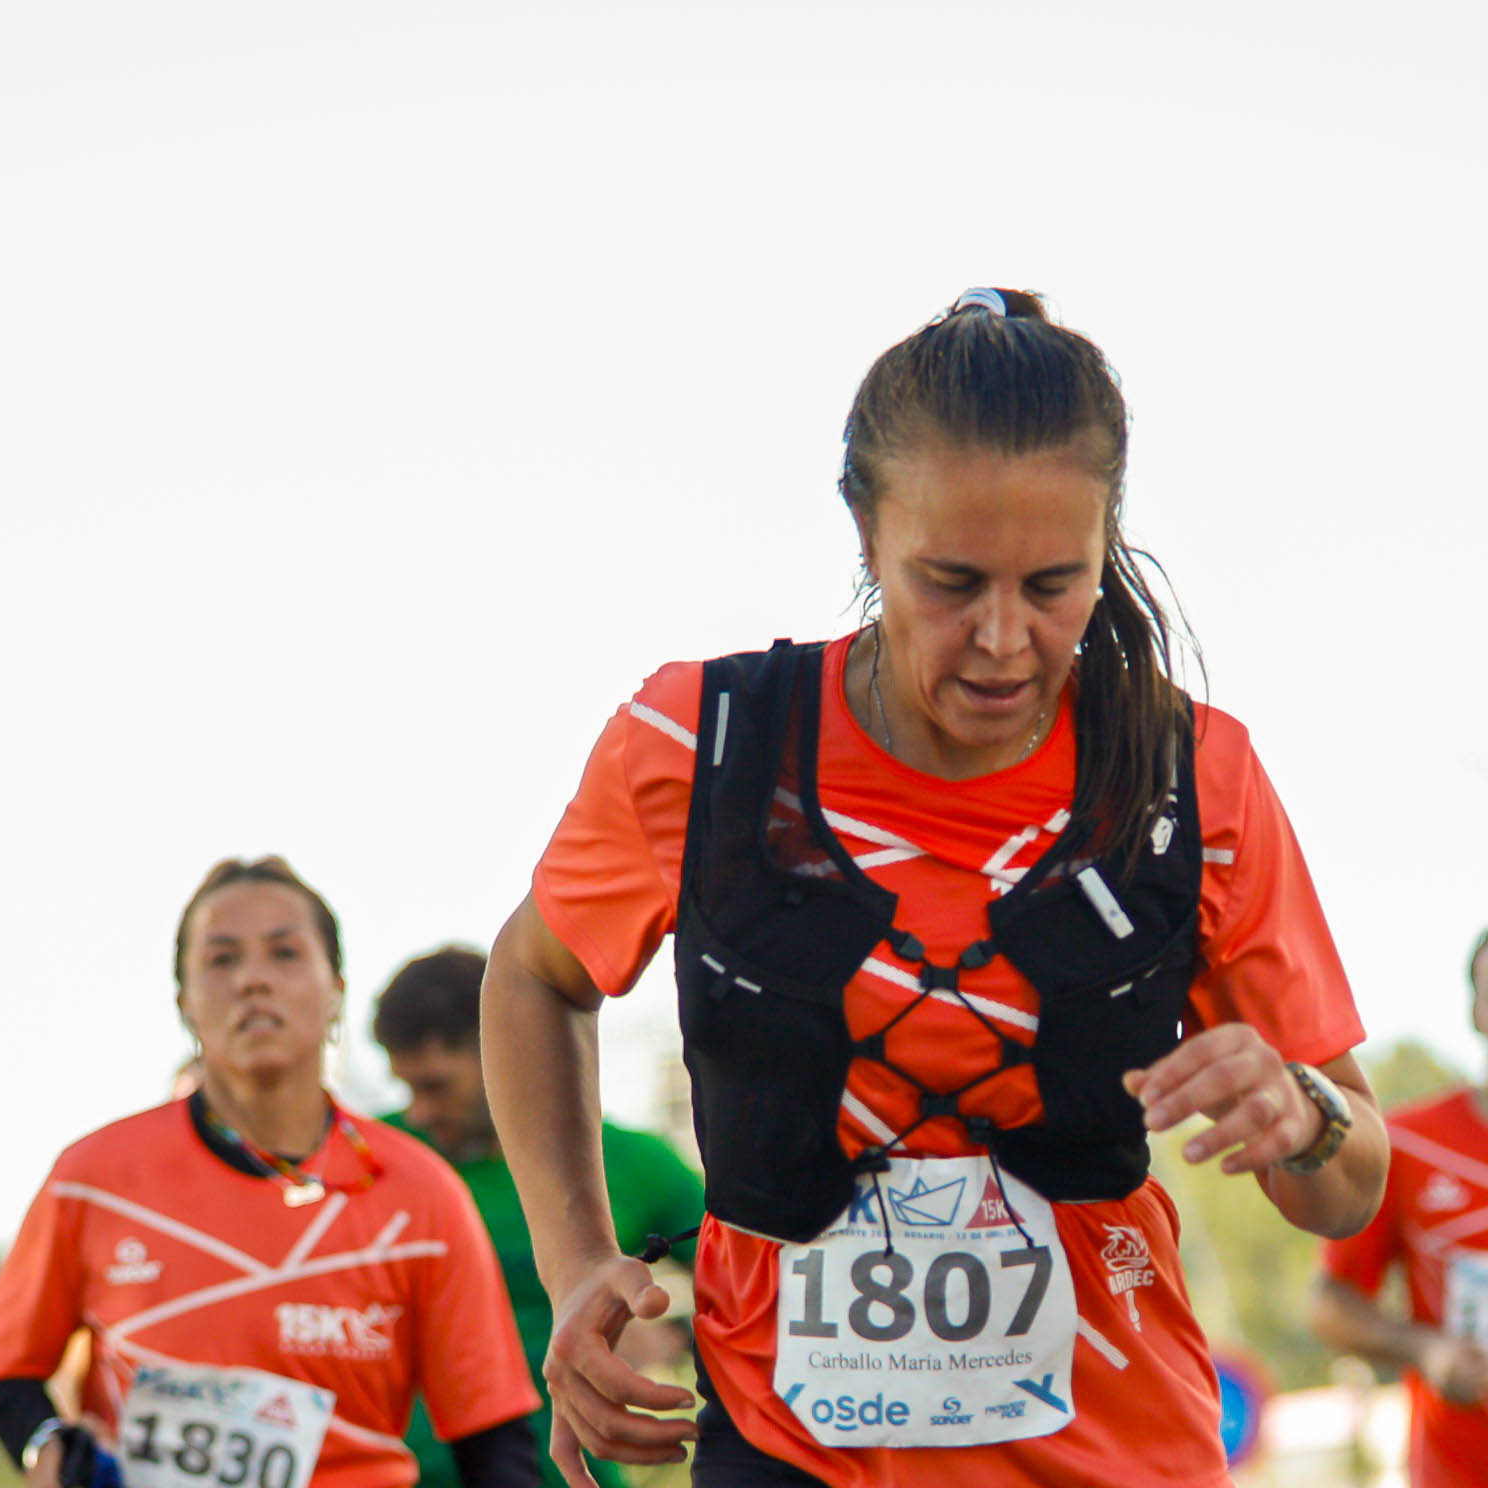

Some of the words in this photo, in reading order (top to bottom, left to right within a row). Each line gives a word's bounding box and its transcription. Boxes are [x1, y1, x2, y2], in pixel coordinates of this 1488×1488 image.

[788, 1245, 1053, 1342] 1807
[1107, 1269, 1156, 1296] ARDEC
[808, 1350, 883, 1371] Carballo
[948, 1350, 1033, 1371] Mercedes
[811, 1392, 911, 1431] osde
